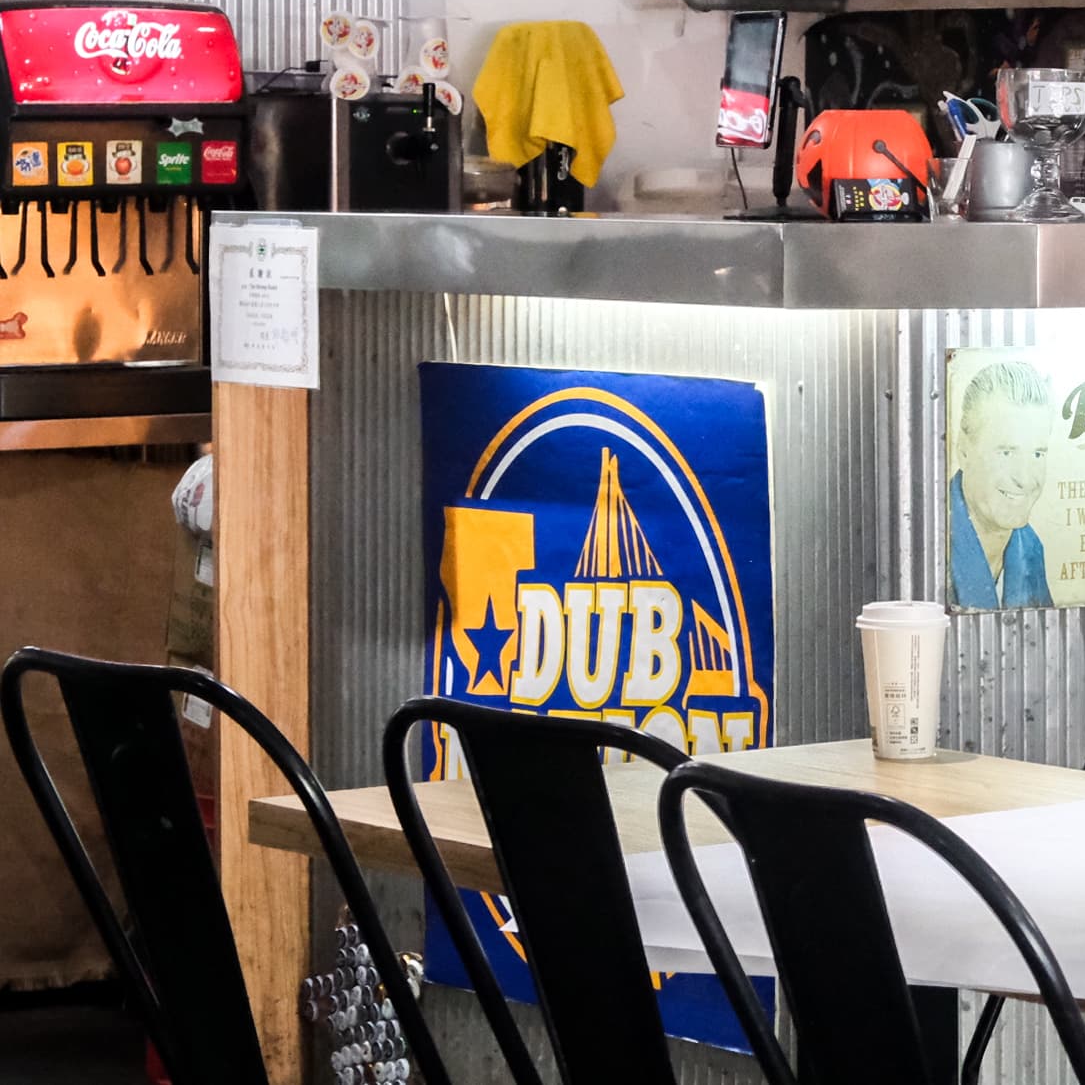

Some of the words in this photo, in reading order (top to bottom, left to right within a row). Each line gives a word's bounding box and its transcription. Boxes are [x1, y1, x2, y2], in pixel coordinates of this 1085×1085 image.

[1032, 85, 1084, 105] TPS
[158, 152, 191, 166] Sprite
[1066, 507, 1072, 526] I
[510, 579, 684, 709] DUB
